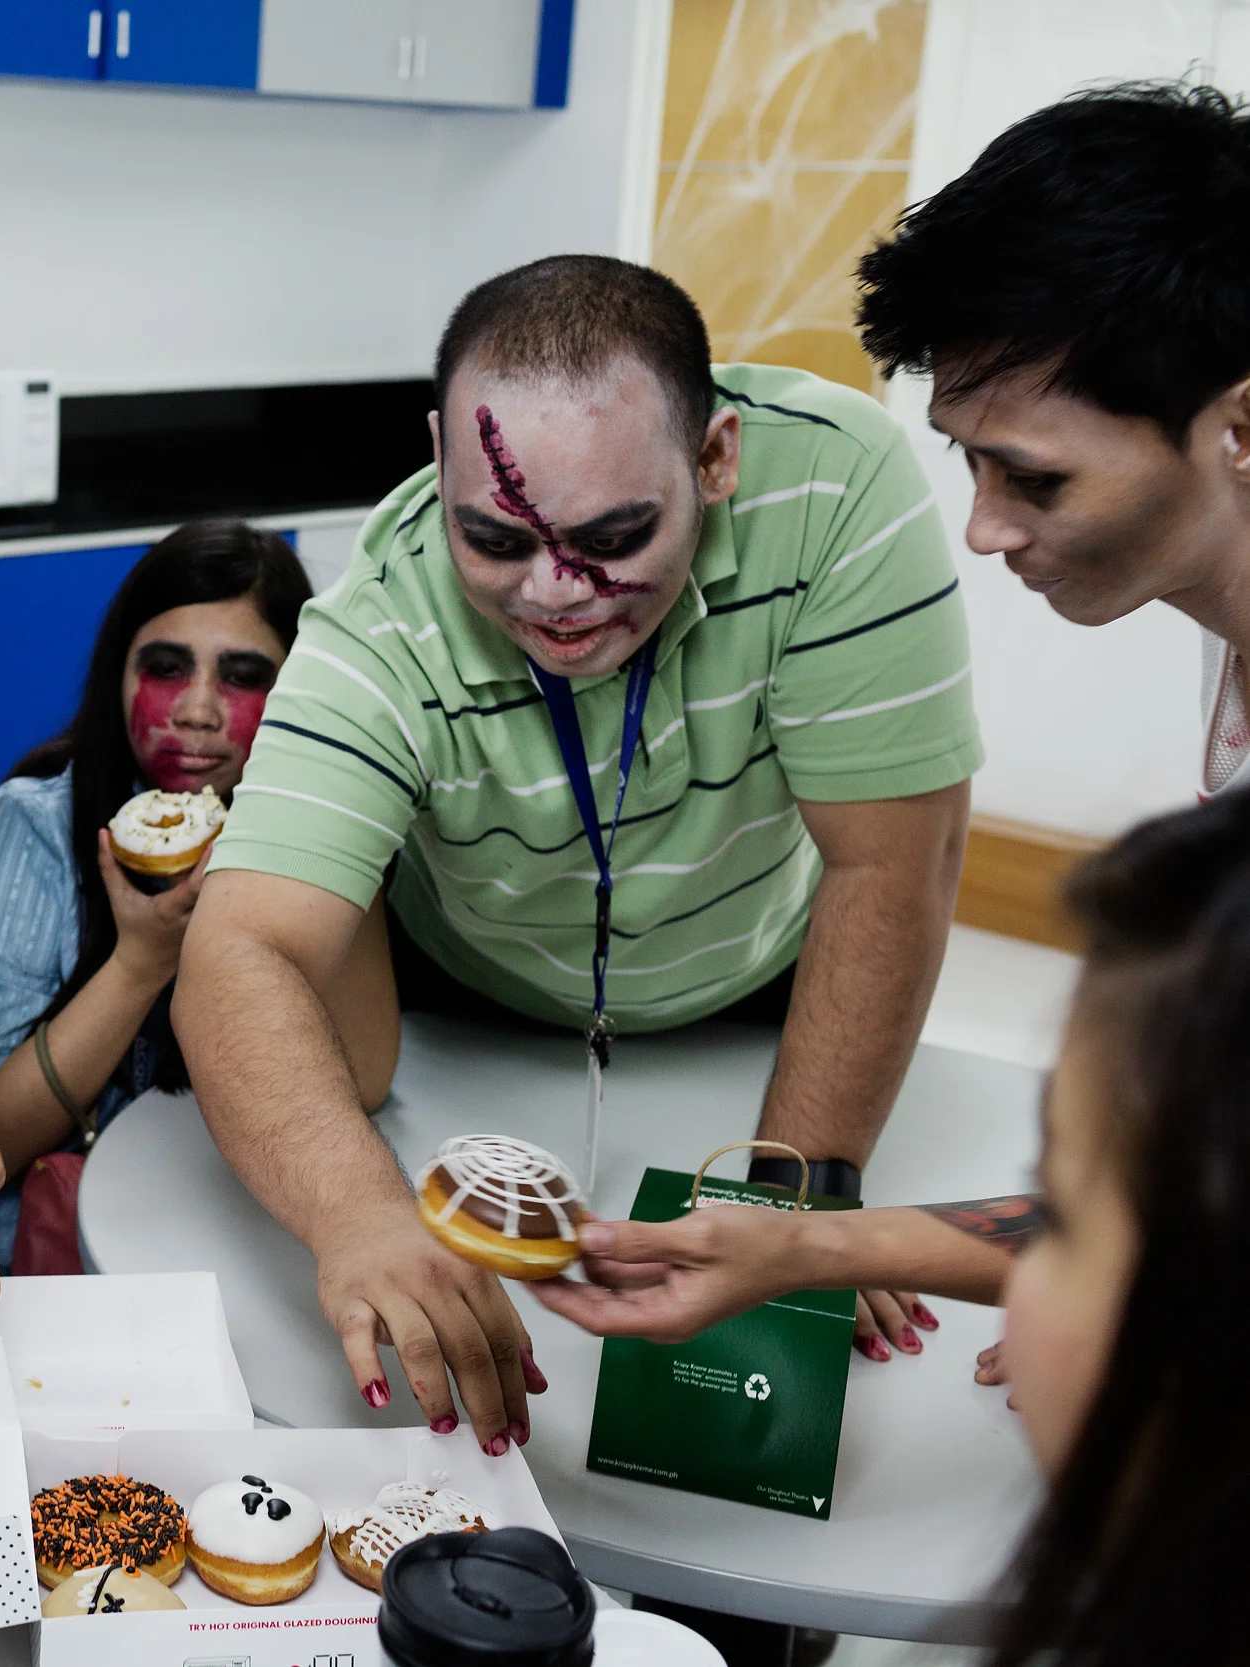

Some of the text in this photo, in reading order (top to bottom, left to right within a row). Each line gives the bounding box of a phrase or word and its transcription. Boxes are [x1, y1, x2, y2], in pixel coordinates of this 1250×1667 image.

[690, 1363, 707, 1372] Kreme
[707, 1368, 732, 1378] promotes
[690, 1378, 699, 1386] the
[597, 1456, 679, 1479] www.krispykreme.com.ph
[188, 1623, 207, 1631] TRY
[209, 1622, 231, 1631] HOT
[232, 1621, 281, 1630] ORIGINAL
[283, 1619, 322, 1628] GLAZED
